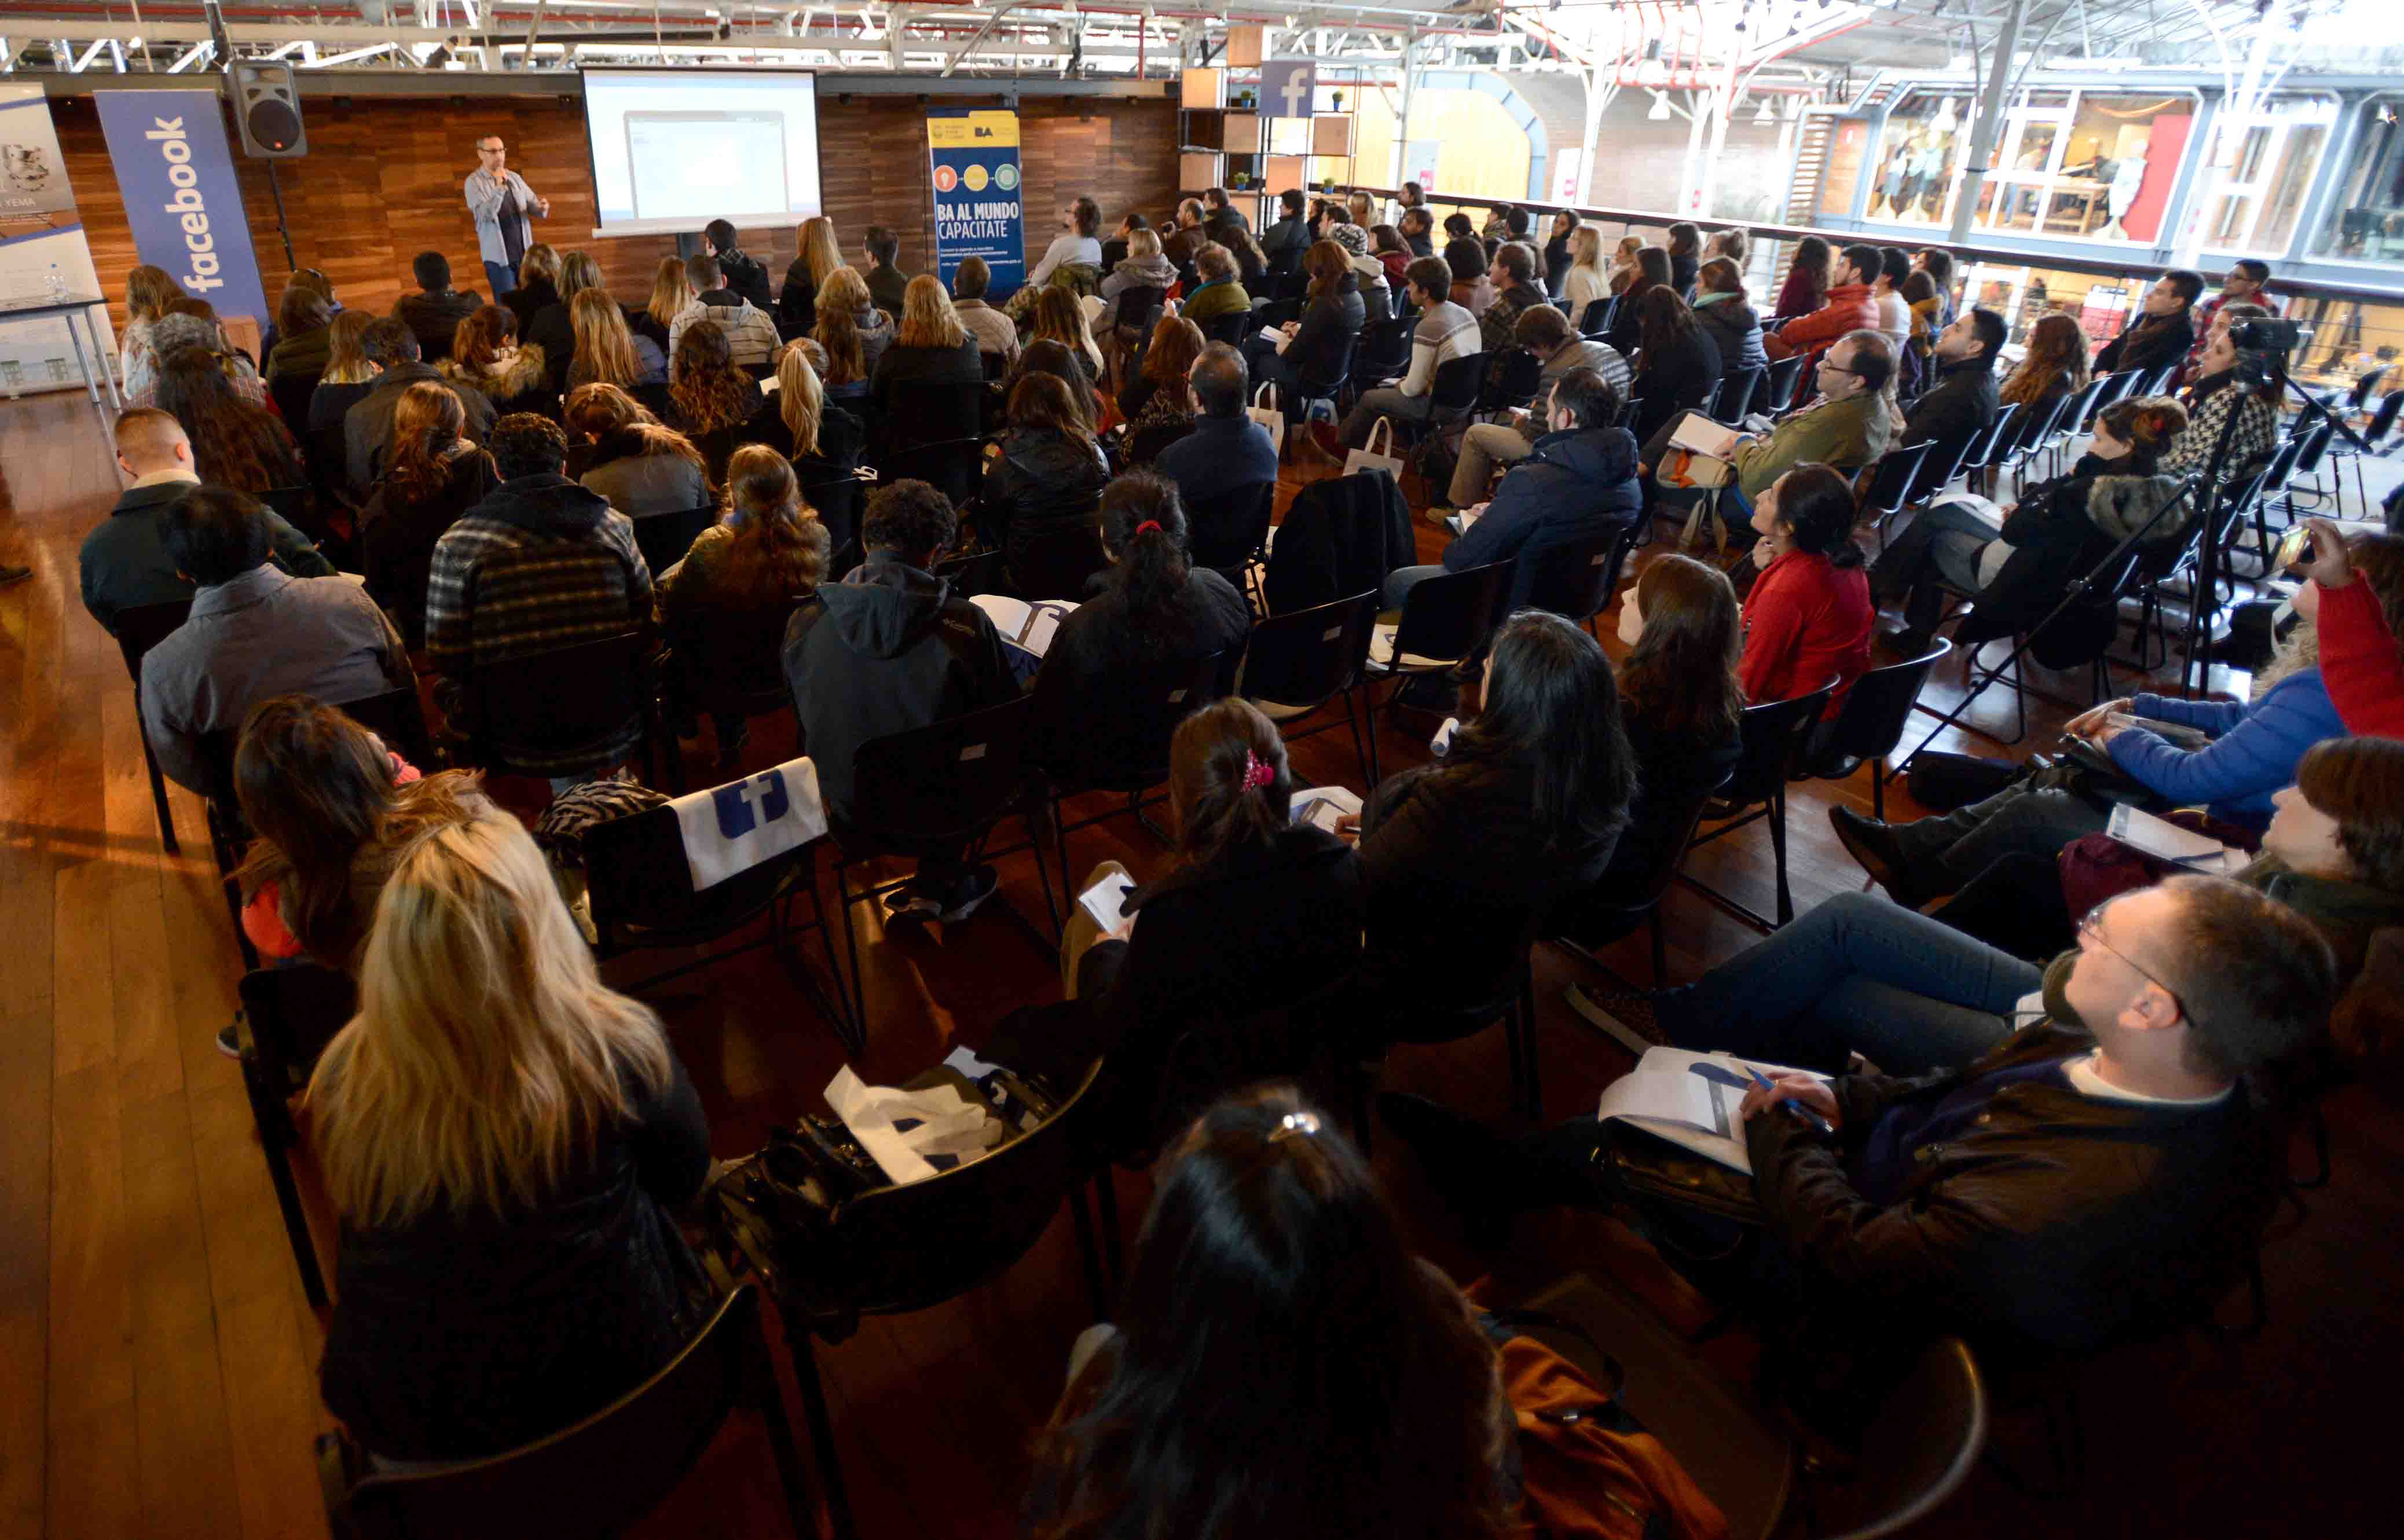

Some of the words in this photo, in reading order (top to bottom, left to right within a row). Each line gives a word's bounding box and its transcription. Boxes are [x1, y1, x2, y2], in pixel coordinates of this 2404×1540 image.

[145, 116, 223, 292] facebook
[937, 204, 954, 221] BA
[957, 203, 972, 221] AL
[974, 202, 1019, 220] MUNDO
[939, 220, 1008, 240] CAPACITATE
